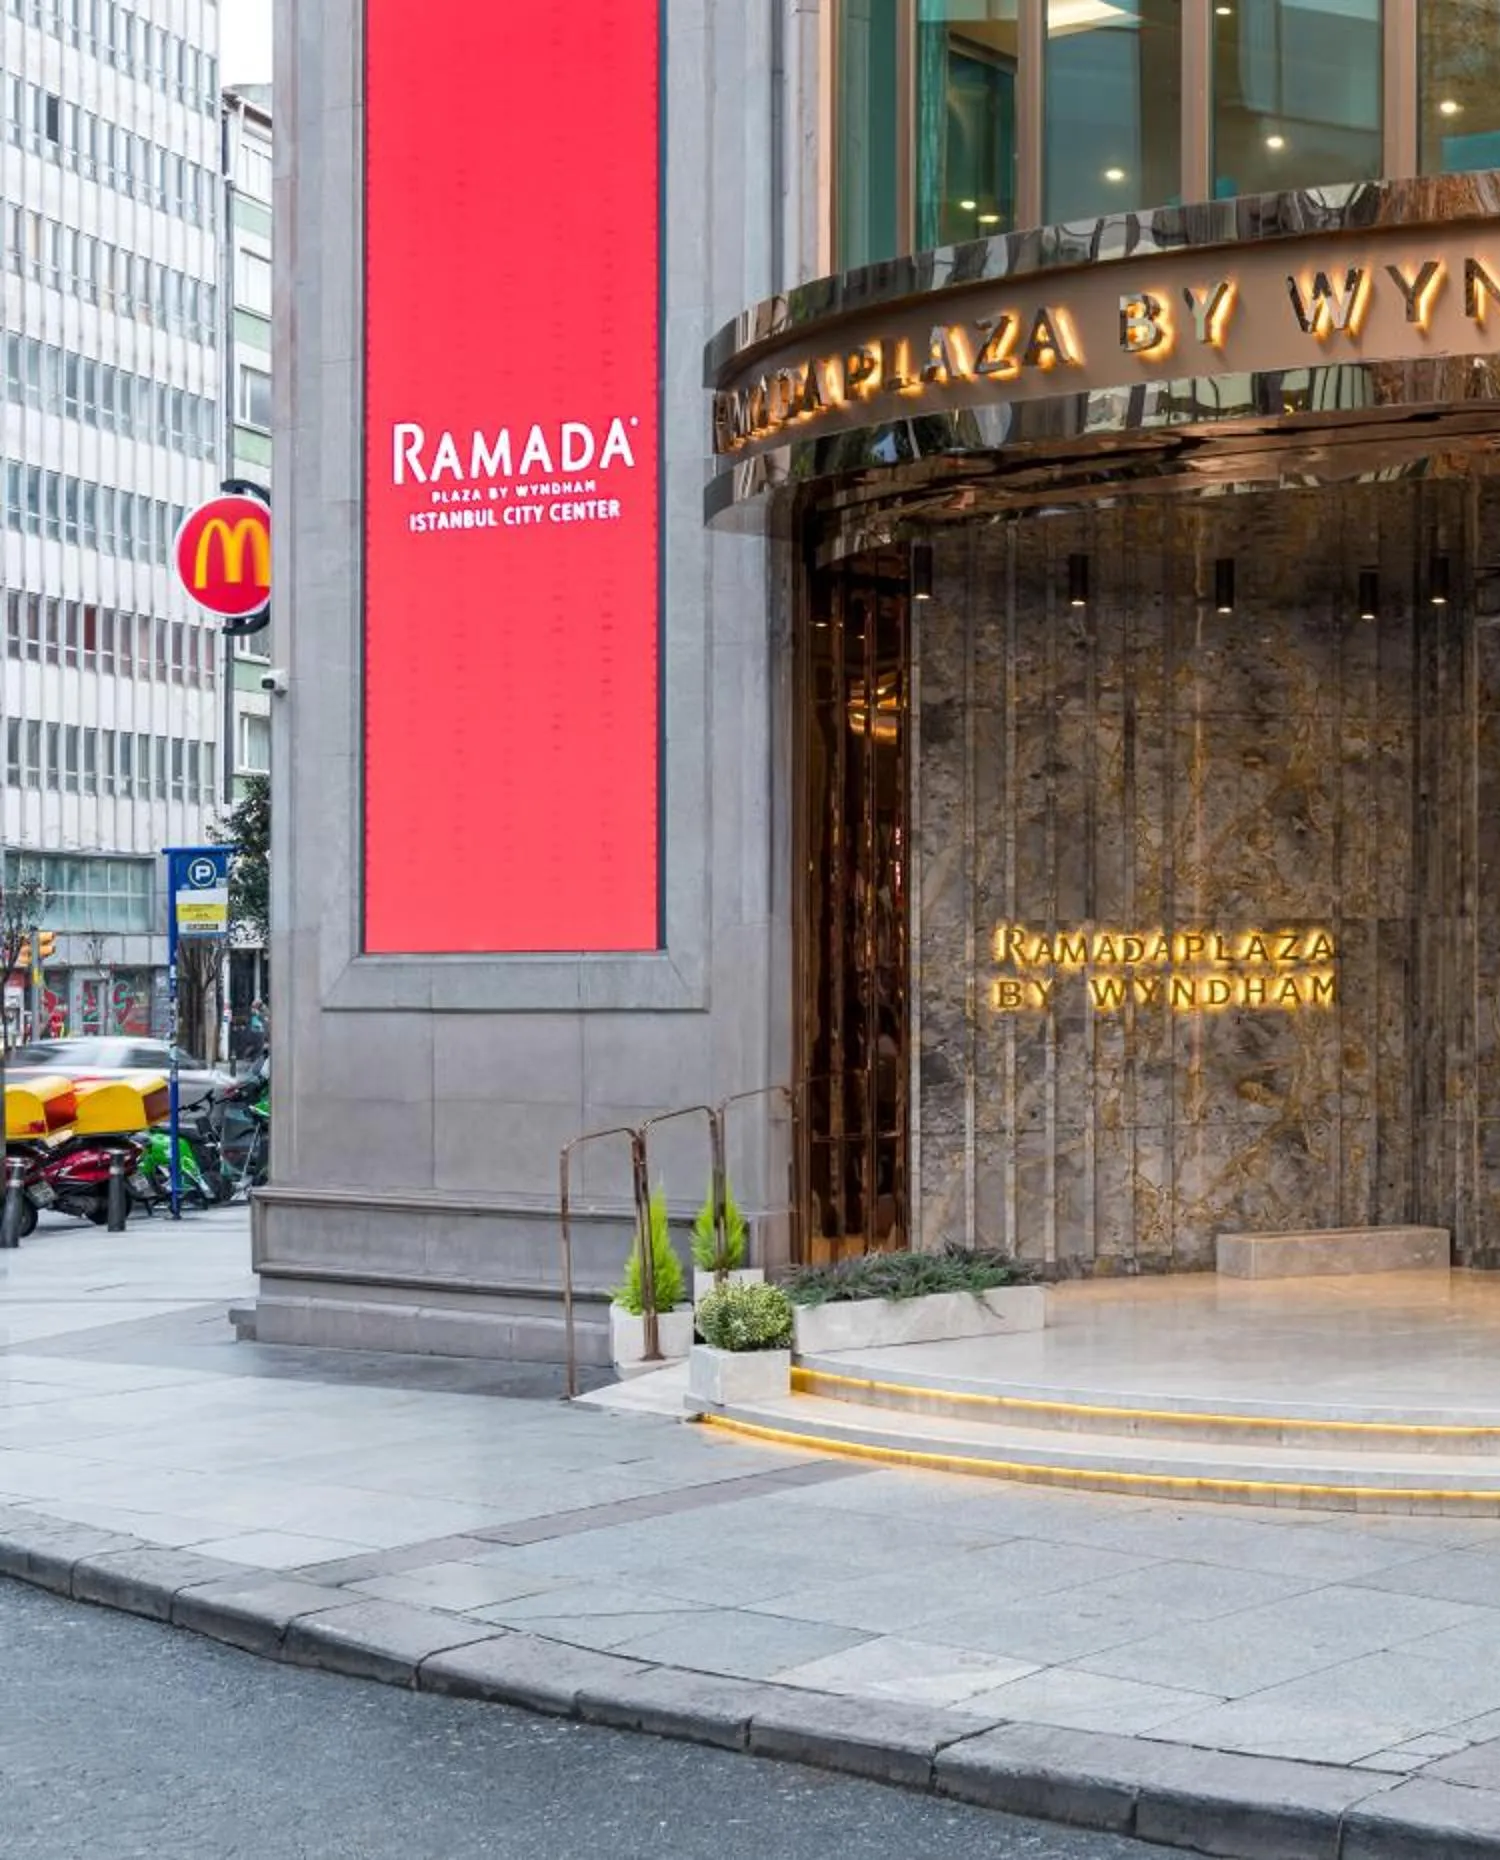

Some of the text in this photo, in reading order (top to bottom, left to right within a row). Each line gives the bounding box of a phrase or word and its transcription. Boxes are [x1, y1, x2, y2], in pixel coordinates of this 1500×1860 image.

[1119, 281, 1235, 353] BY
[393, 417, 635, 485] RAMADA
[431, 480, 597, 504] PLAZA BY WYNDHAM
[409, 499, 621, 532] ISTANBUL CITY CENTER
[998, 975, 1337, 1009] BY WYNDHAM
